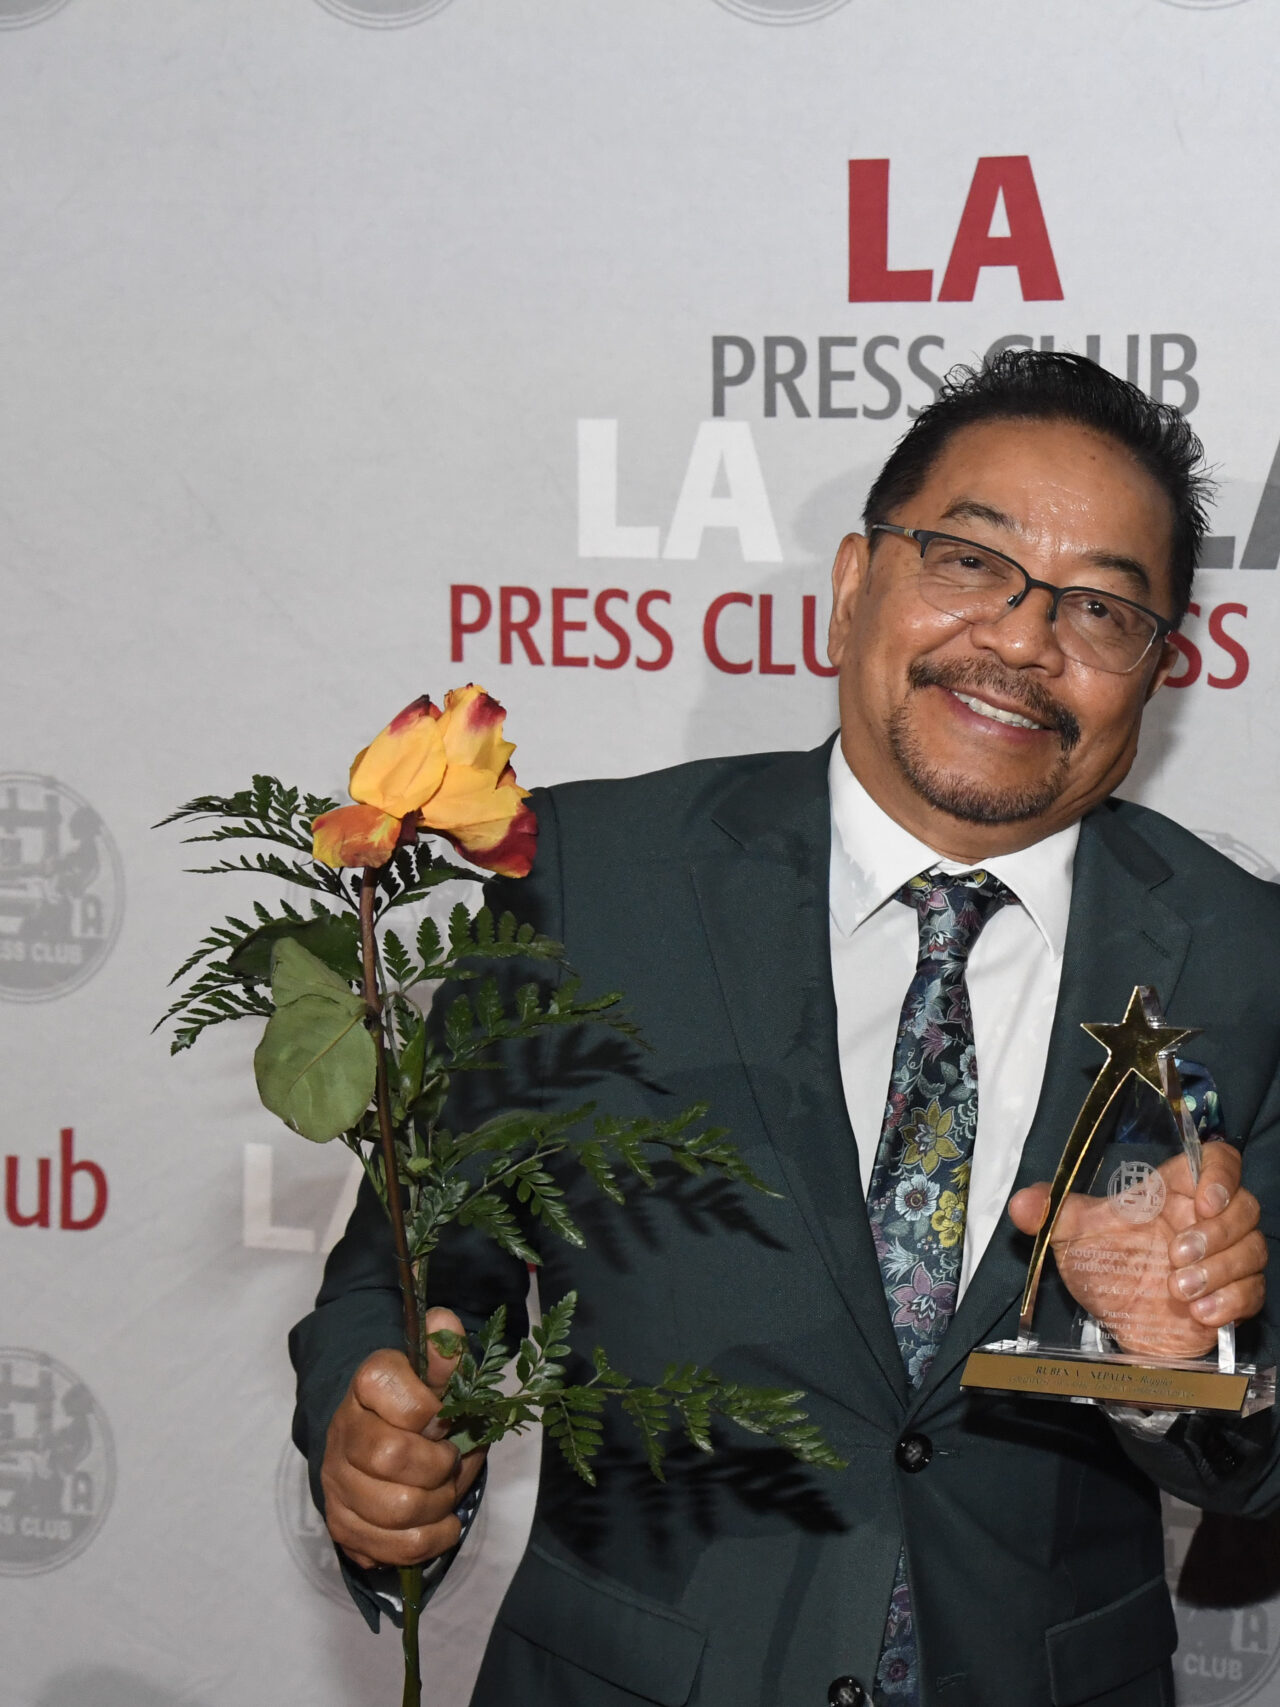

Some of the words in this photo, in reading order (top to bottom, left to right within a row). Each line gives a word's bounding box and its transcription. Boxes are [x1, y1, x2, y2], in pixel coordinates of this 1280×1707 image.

[848, 155, 1064, 303] LA
[712, 335, 945, 421] PRESS
[577, 419, 784, 563] LA
[449, 584, 673, 671] PRESS
[703, 591, 841, 678] CLU
[1183, 1653, 1243, 1681] CLUB
